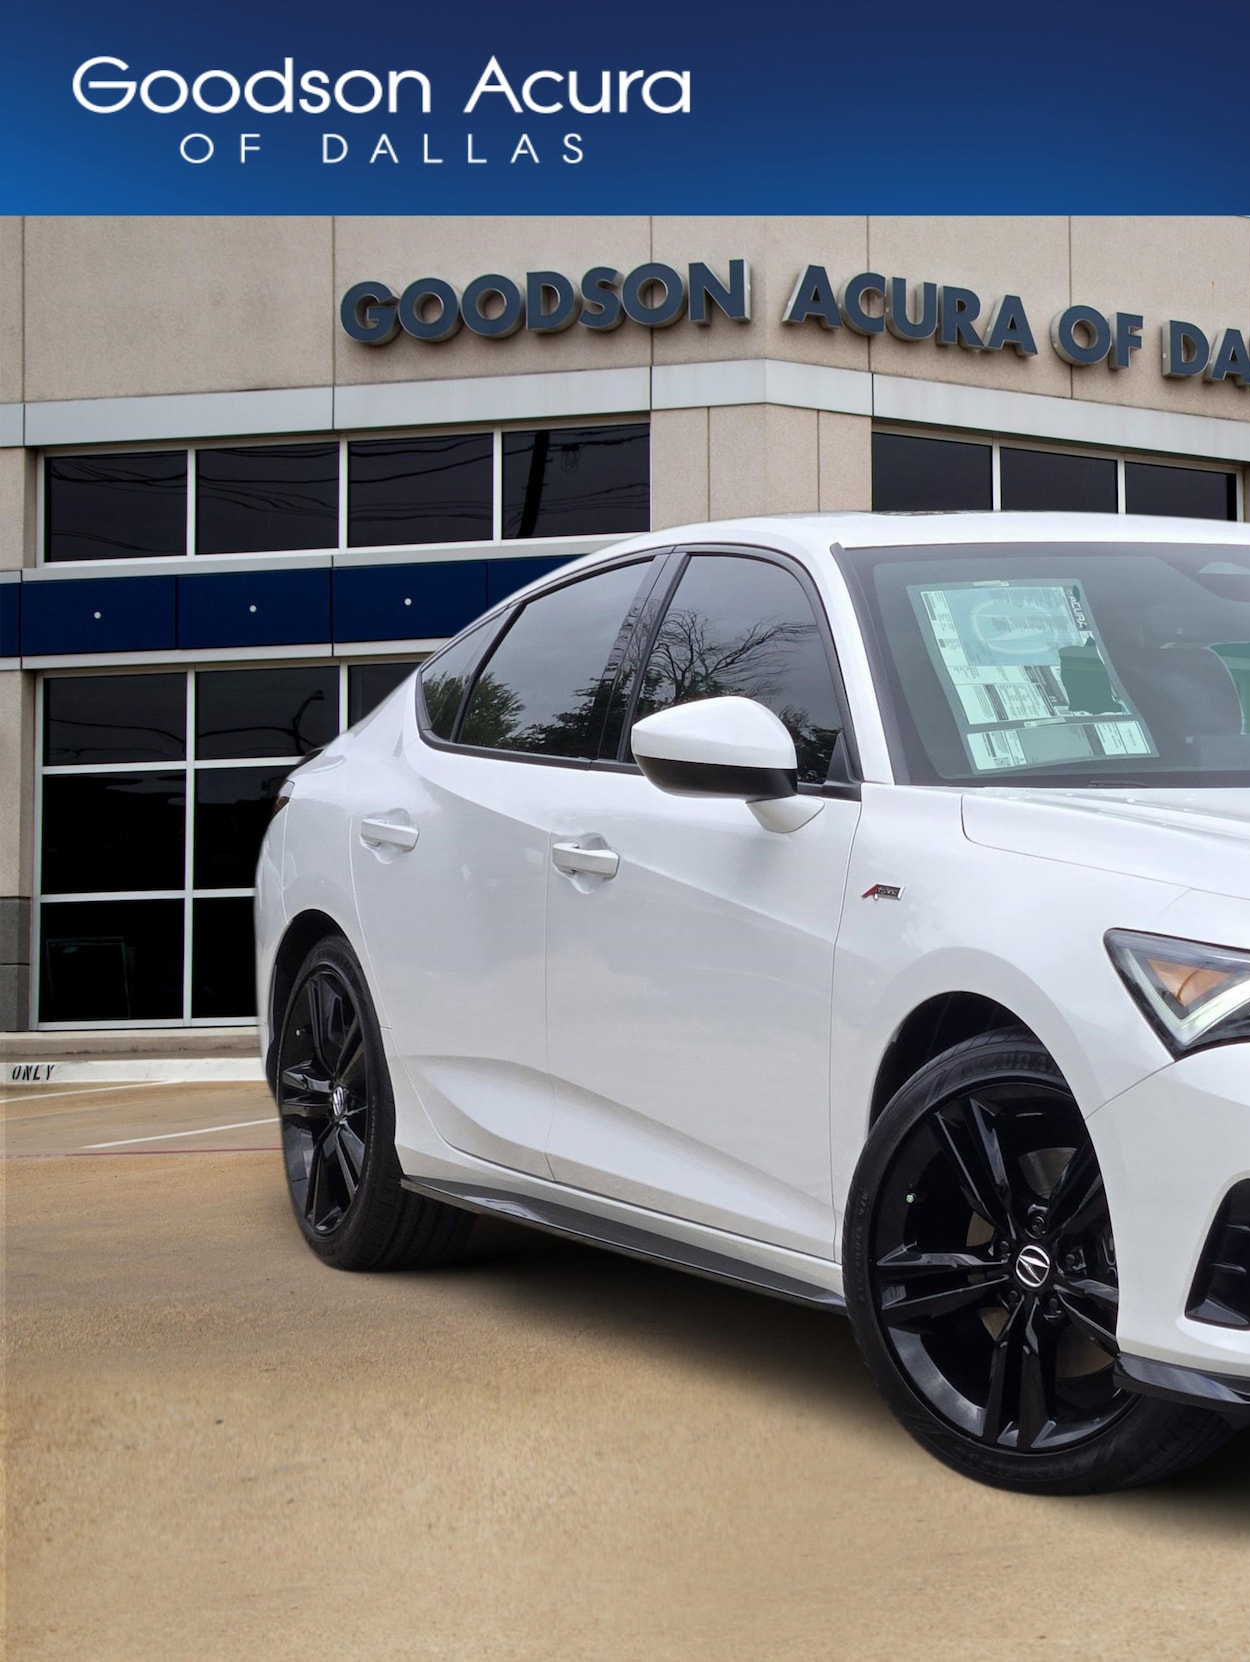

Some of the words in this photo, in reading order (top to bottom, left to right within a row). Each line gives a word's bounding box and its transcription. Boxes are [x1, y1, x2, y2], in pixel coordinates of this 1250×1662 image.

[340, 259, 751, 345] GOODSON
[782, 264, 1038, 357] ACURA
[1050, 304, 1144, 371] OF
[11, 1064, 55, 1081] ONLY
